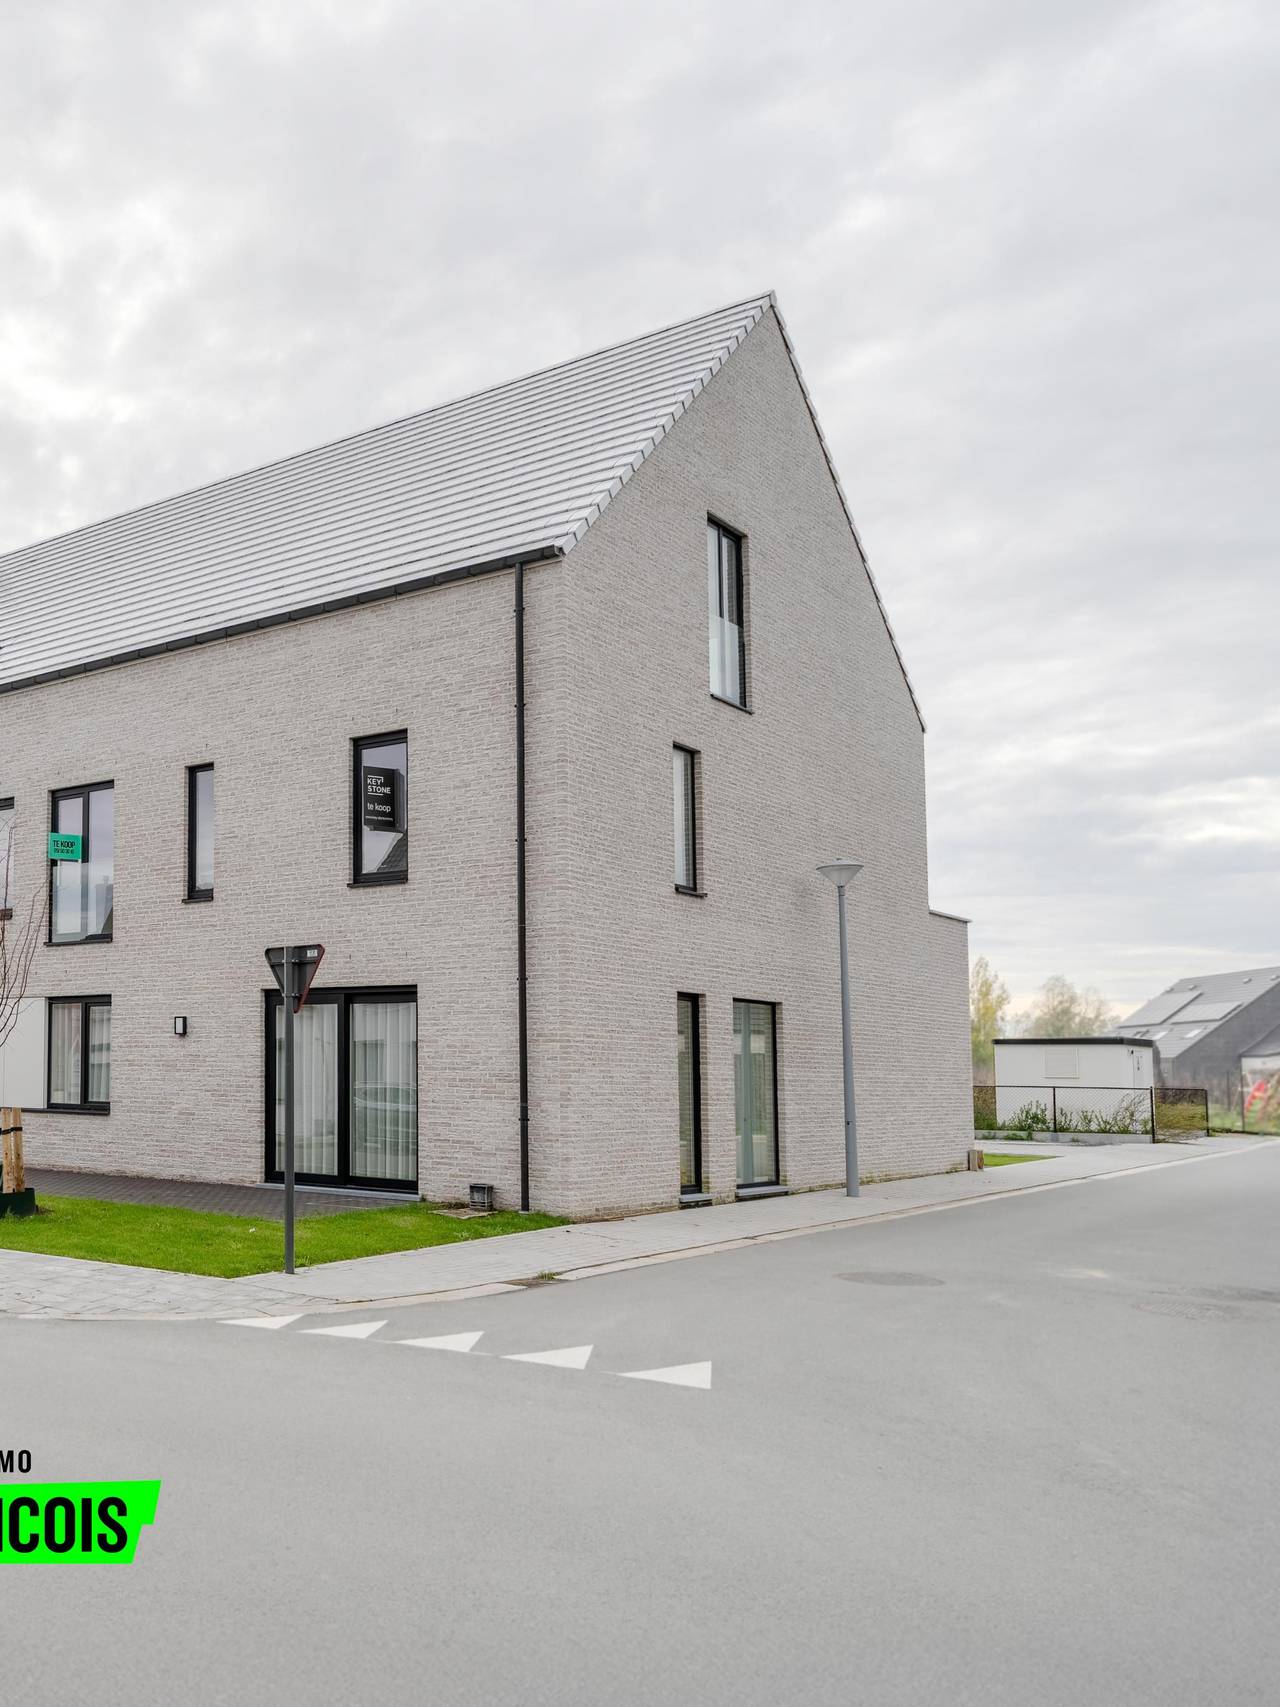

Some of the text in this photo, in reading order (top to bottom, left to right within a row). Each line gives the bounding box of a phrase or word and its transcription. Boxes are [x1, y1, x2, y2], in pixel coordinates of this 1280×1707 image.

[368, 777, 381, 786] KEY
[368, 785, 392, 794] STONE
[367, 802, 392, 813] te koop
[53, 840, 76, 849] TE KOOP
